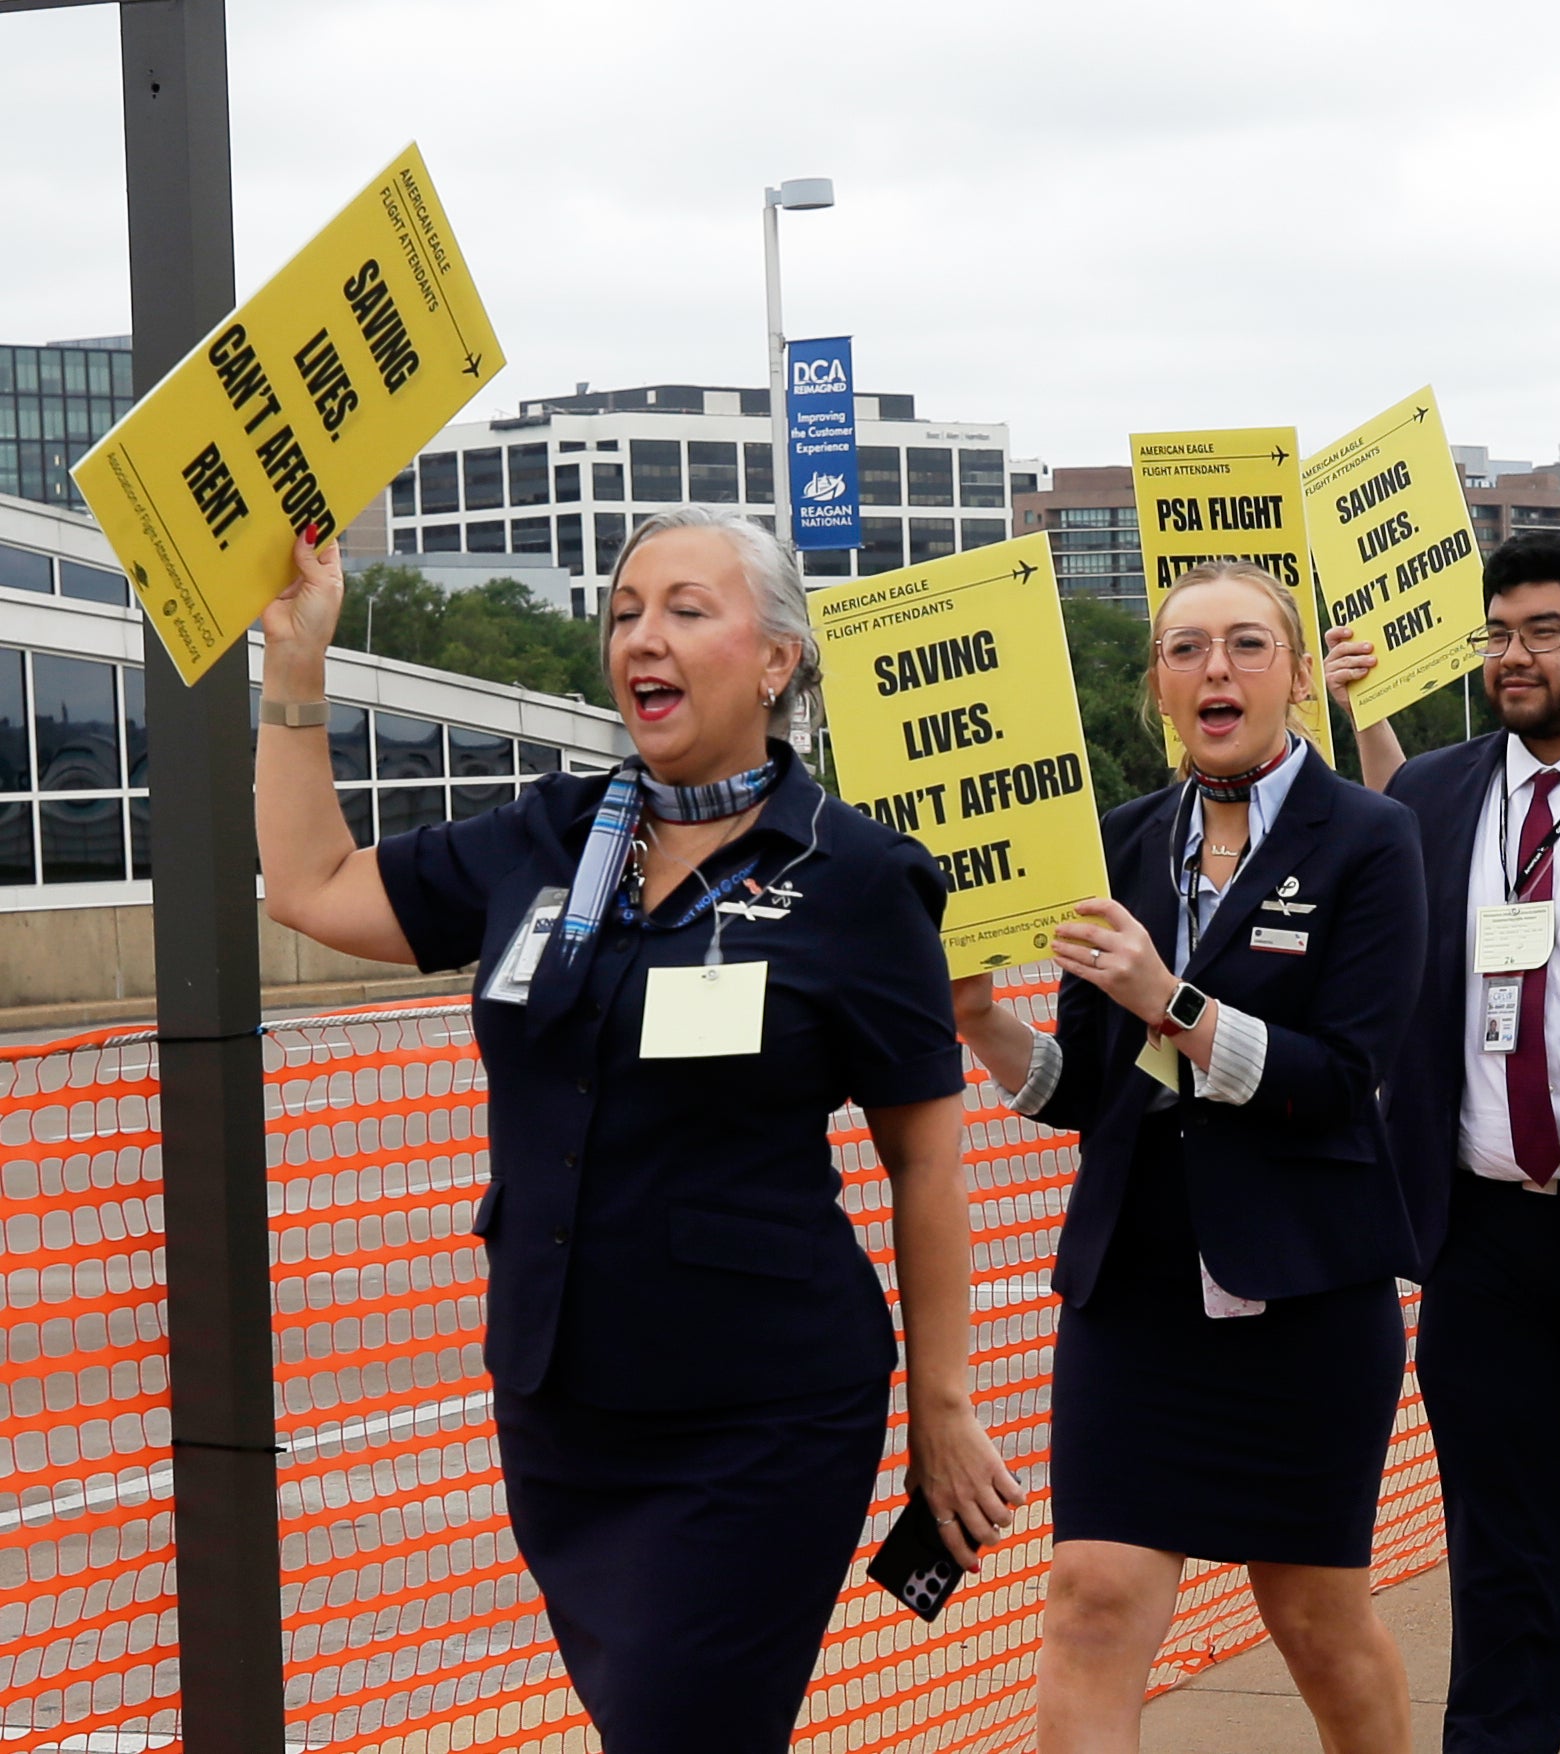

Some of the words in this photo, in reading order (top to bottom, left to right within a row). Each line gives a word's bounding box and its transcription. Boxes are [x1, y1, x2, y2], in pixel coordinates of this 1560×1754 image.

[399, 168, 433, 235] AMERICAN
[426, 231, 451, 275] EAGLE
[379, 186, 407, 233] FLIGHT
[398, 232, 439, 313] ATTENDANTS
[343, 259, 420, 395] SAVING
[293, 327, 359, 443] LIVES.
[794, 359, 847, 384] DCA
[794, 383, 847, 395] REIMAGINED
[208, 323, 282, 436] CAN'T
[256, 424, 336, 549] AFFORD
[791, 427, 806, 439] the
[808, 426, 853, 437] Customer
[797, 411, 846, 424] Improving
[796, 442, 849, 455] Experience
[1140, 445, 1185, 456] AMERICAN
[1186, 443, 1214, 454] EAGLE
[1142, 465, 1172, 476] FLIGHT
[1173, 464, 1231, 476] ATTENDANTS
[1302, 453, 1340, 480] AMERICAN
[1340, 437, 1364, 458] EAGLE
[1305, 477, 1331, 497] FLIGHT
[1331, 446, 1380, 482] ATTENDANTS
[181, 441, 249, 551] RENT.
[800, 504, 852, 518] REAGAN
[1156, 497, 1203, 532] PSA
[1209, 496, 1283, 530] FLIGHT
[1335, 460, 1412, 525] SAVING
[801, 516, 852, 528] NATIONAL
[1357, 510, 1420, 564] LIVES.
[822, 587, 888, 617] AMERICAN
[889, 579, 930, 602] EAGLE
[1332, 573, 1389, 627] CAN'T
[1397, 528, 1472, 595] AFFORD
[826, 620, 869, 641] FLIGHT
[872, 599, 954, 631] ATTENDANTS
[1383, 600, 1442, 652] RENT.
[874, 629, 999, 697] SAVING
[903, 702, 1003, 761] LIVES.
[960, 753, 1084, 818] AFFORD
[949, 934, 976, 948] Flight
